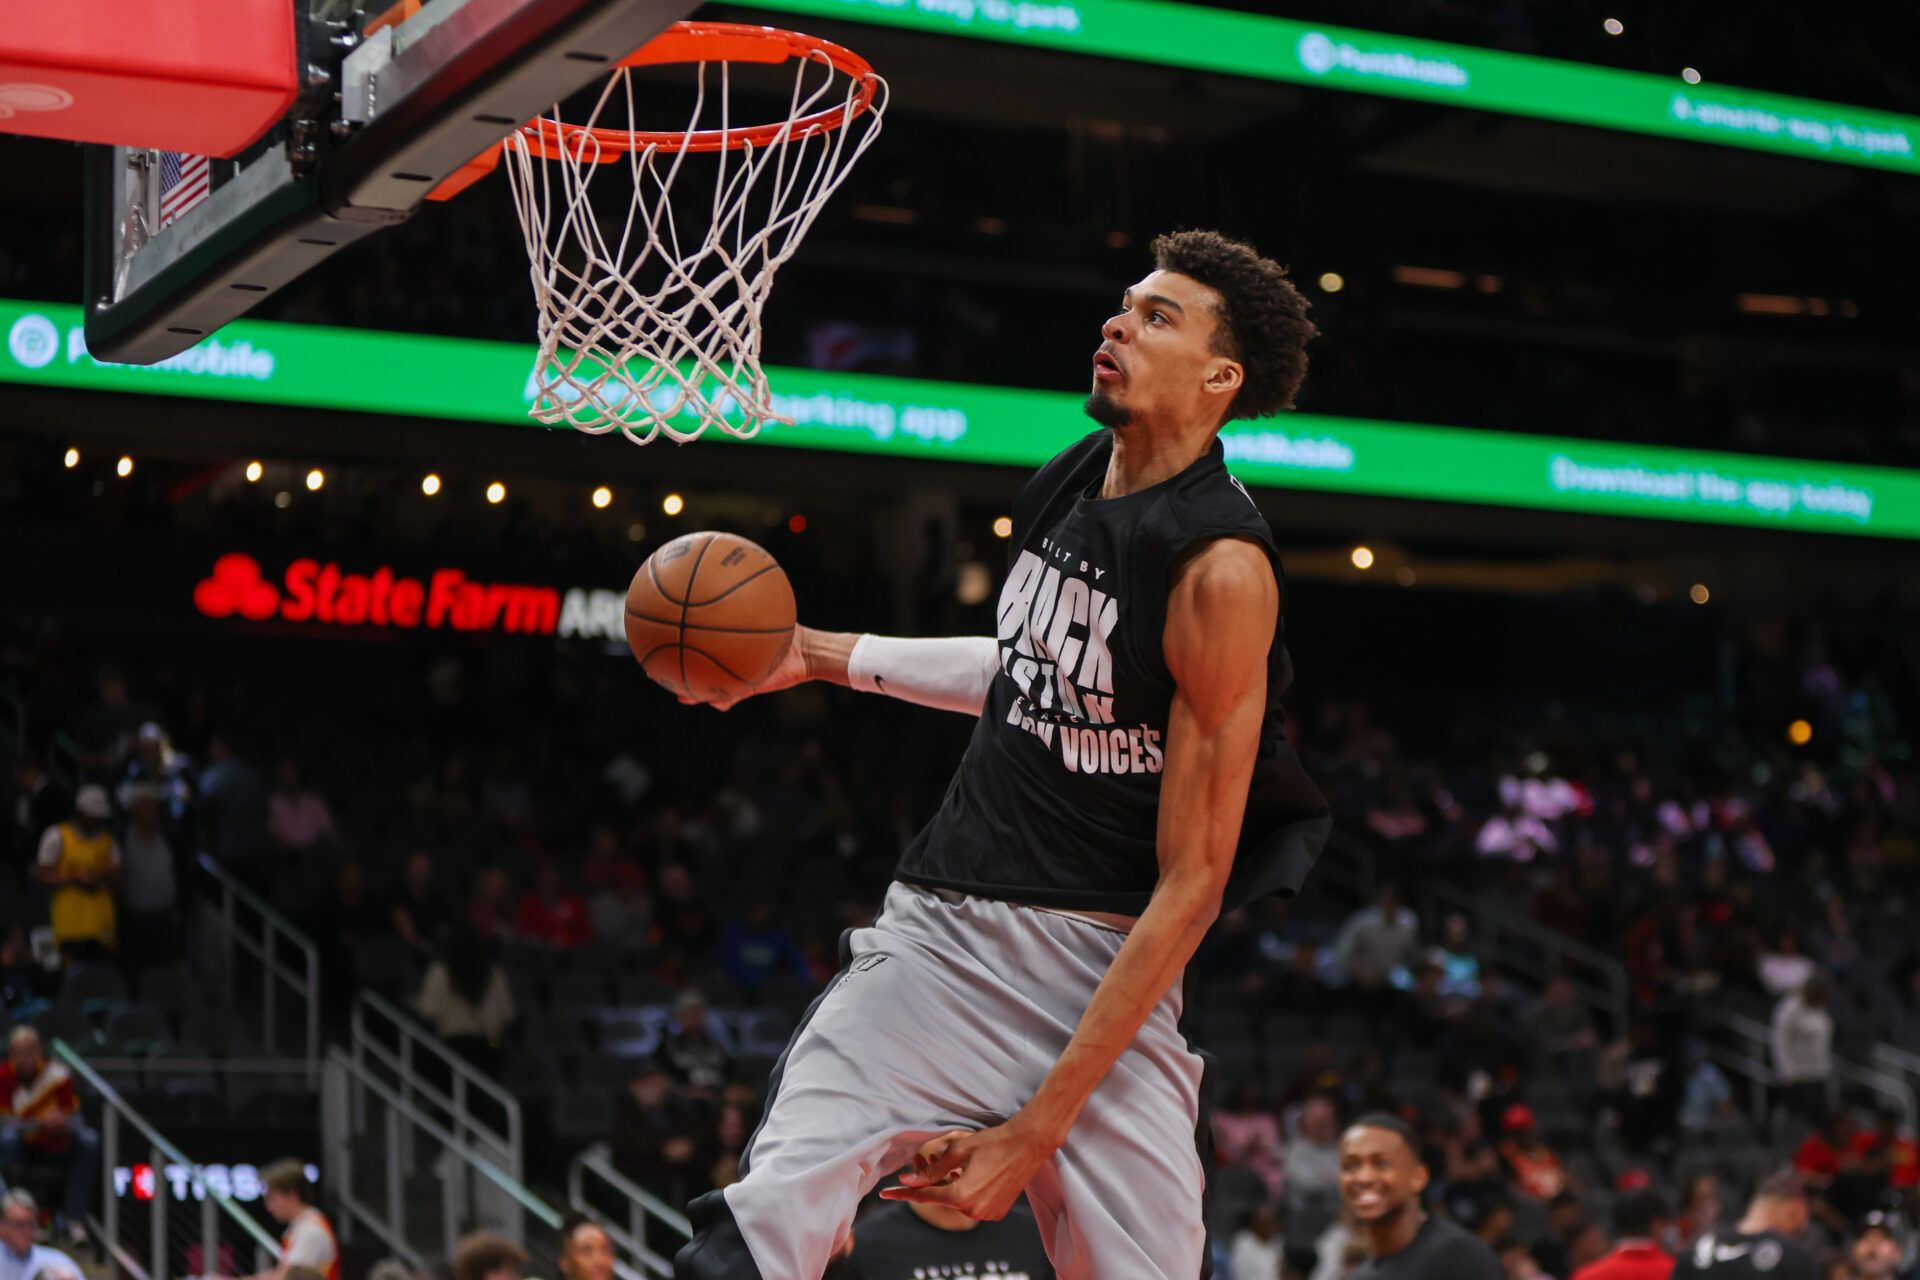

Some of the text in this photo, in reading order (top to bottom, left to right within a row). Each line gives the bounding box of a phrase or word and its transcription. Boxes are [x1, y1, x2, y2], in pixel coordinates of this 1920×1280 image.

[1080, 560, 1106, 580] BY
[280, 558, 425, 628] State
[425, 567, 560, 635] Farm
